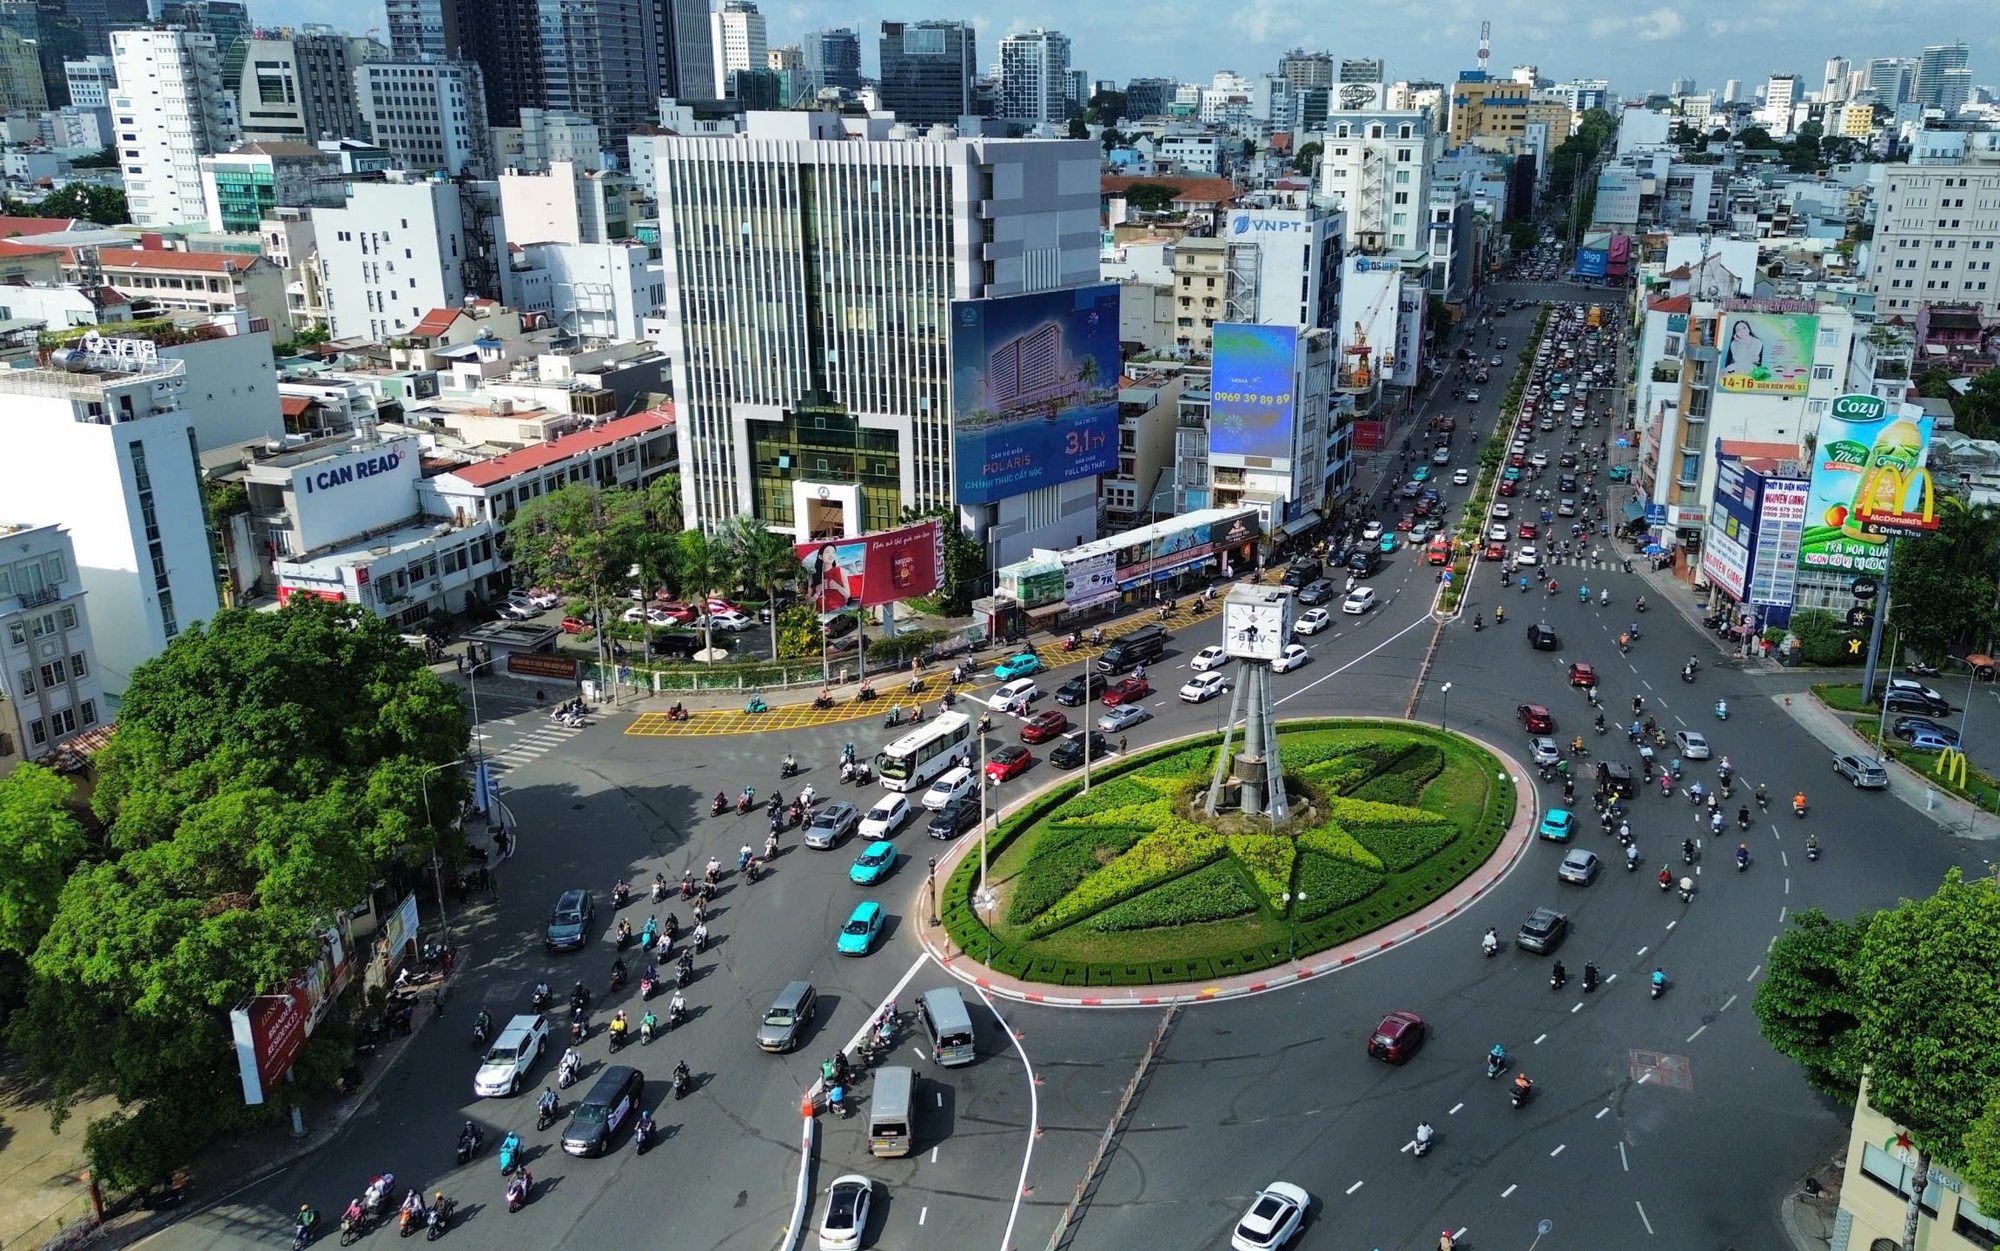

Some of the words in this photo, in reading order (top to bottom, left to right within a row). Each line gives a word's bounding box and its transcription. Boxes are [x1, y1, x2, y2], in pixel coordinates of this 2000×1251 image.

[1251, 220, 1302, 232] VNPT
[1721, 377, 1754, 389] 14-16
[1214, 392, 1240, 402] 0969
[1243, 394, 1257, 403] 39
[1260, 395, 1274, 405] 89
[1276, 394, 1290, 404] 89
[1837, 399, 1880, 417] Cozy
[1065, 429, 1089, 456] 3,1
[1834, 450, 1864, 463] Mới
[983, 455, 1032, 475] POLARIS
[306, 476, 313, 494] I
[317, 465, 353, 490] CAN
[356, 453, 400, 480] READ
[1065, 468, 1079, 477] FULL
[964, 477, 993, 490] CHÍNH
[1870, 514, 1922, 526] McDonald's
[1880, 526, 1902, 535] Drive
[1904, 528, 1921, 537] Thru
[1825, 541, 1842, 553] TRÀ
[1846, 544, 1864, 555] HOA
[1869, 543, 1889, 557] QUẢ
[1805, 554, 1828, 565] NGON
[1101, 574, 1113, 587] 7K
